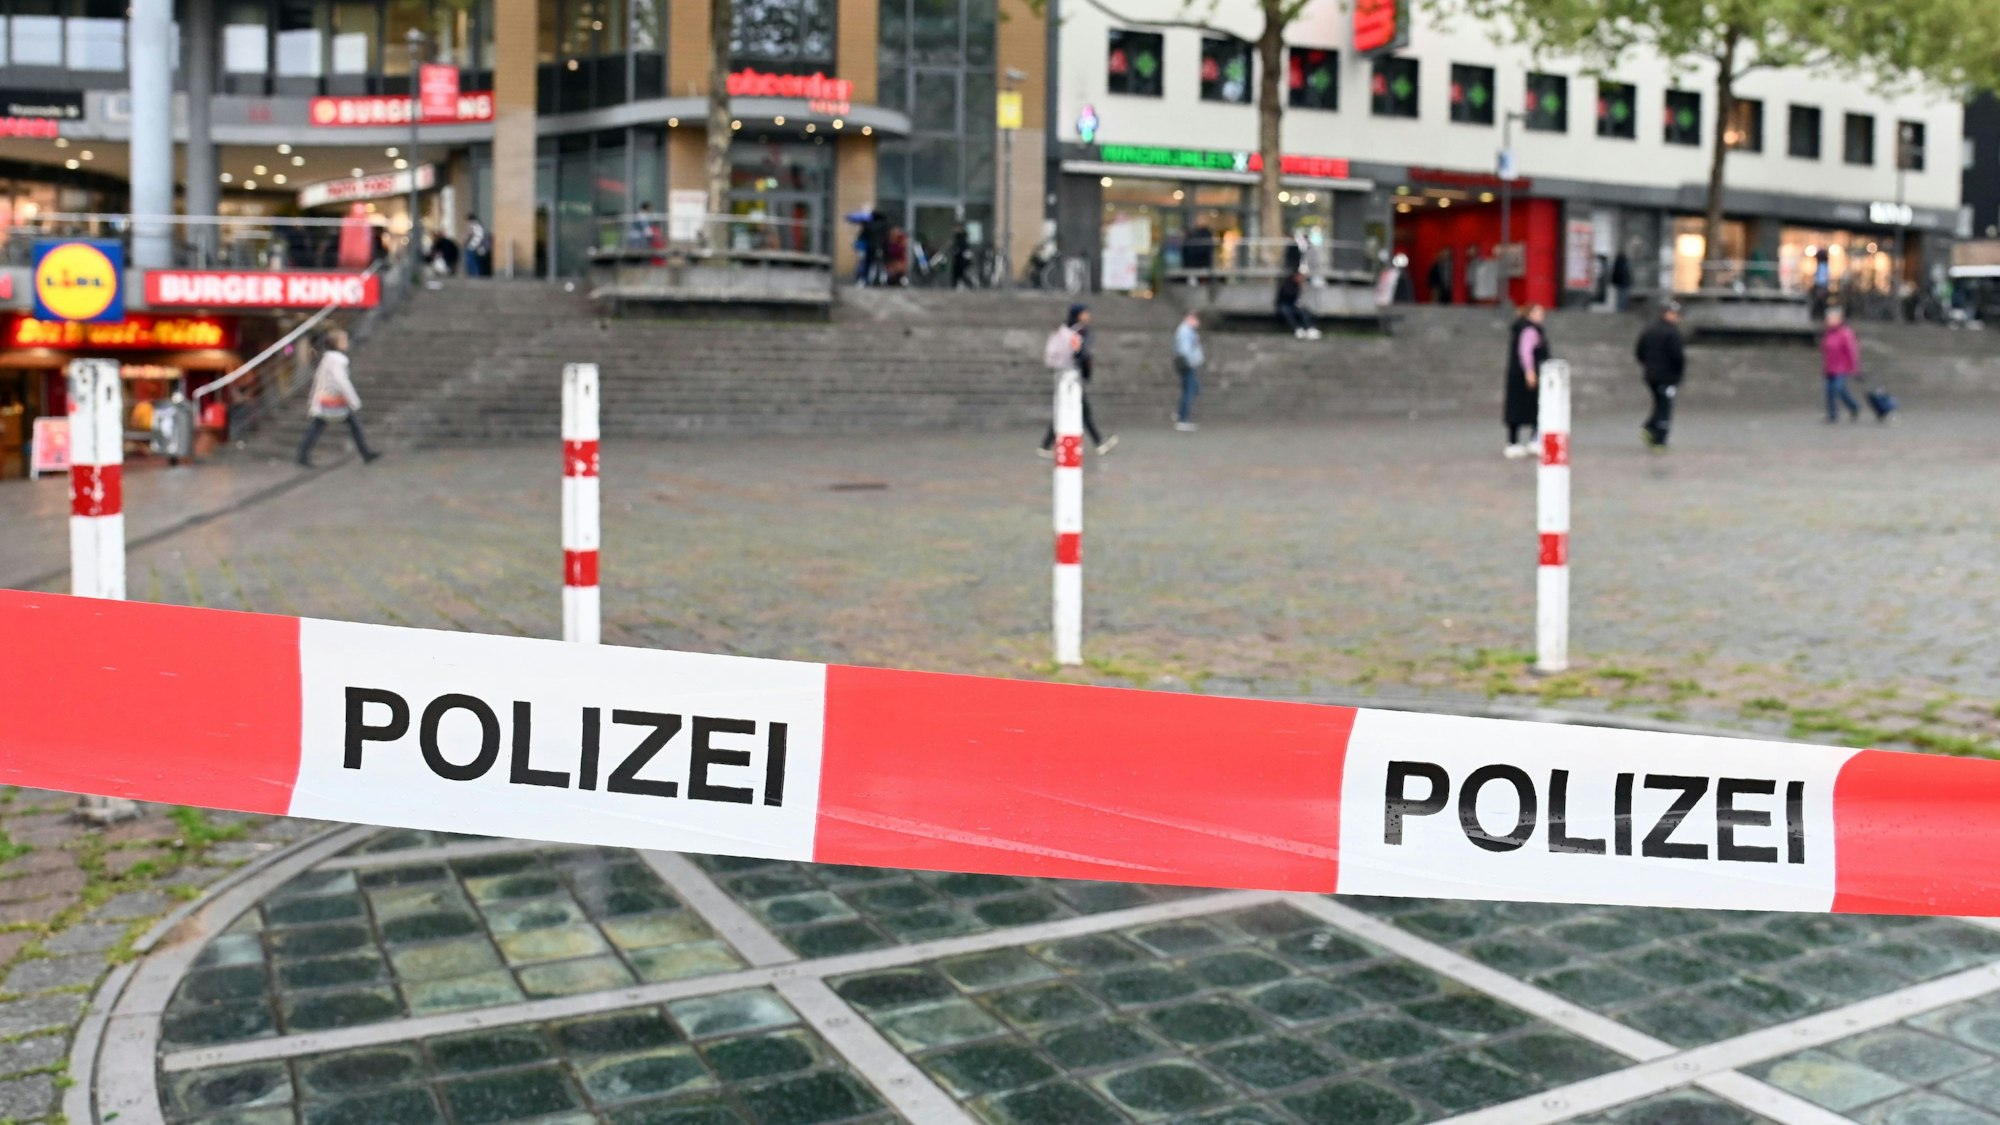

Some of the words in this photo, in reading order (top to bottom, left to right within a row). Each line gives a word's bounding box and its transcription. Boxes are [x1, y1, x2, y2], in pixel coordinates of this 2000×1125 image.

[160, 275, 281, 301] BURGER
[287, 277, 364, 304] KING
[343, 686, 788, 808] POLIZEI
[1384, 760, 1806, 864] POLIZEI
